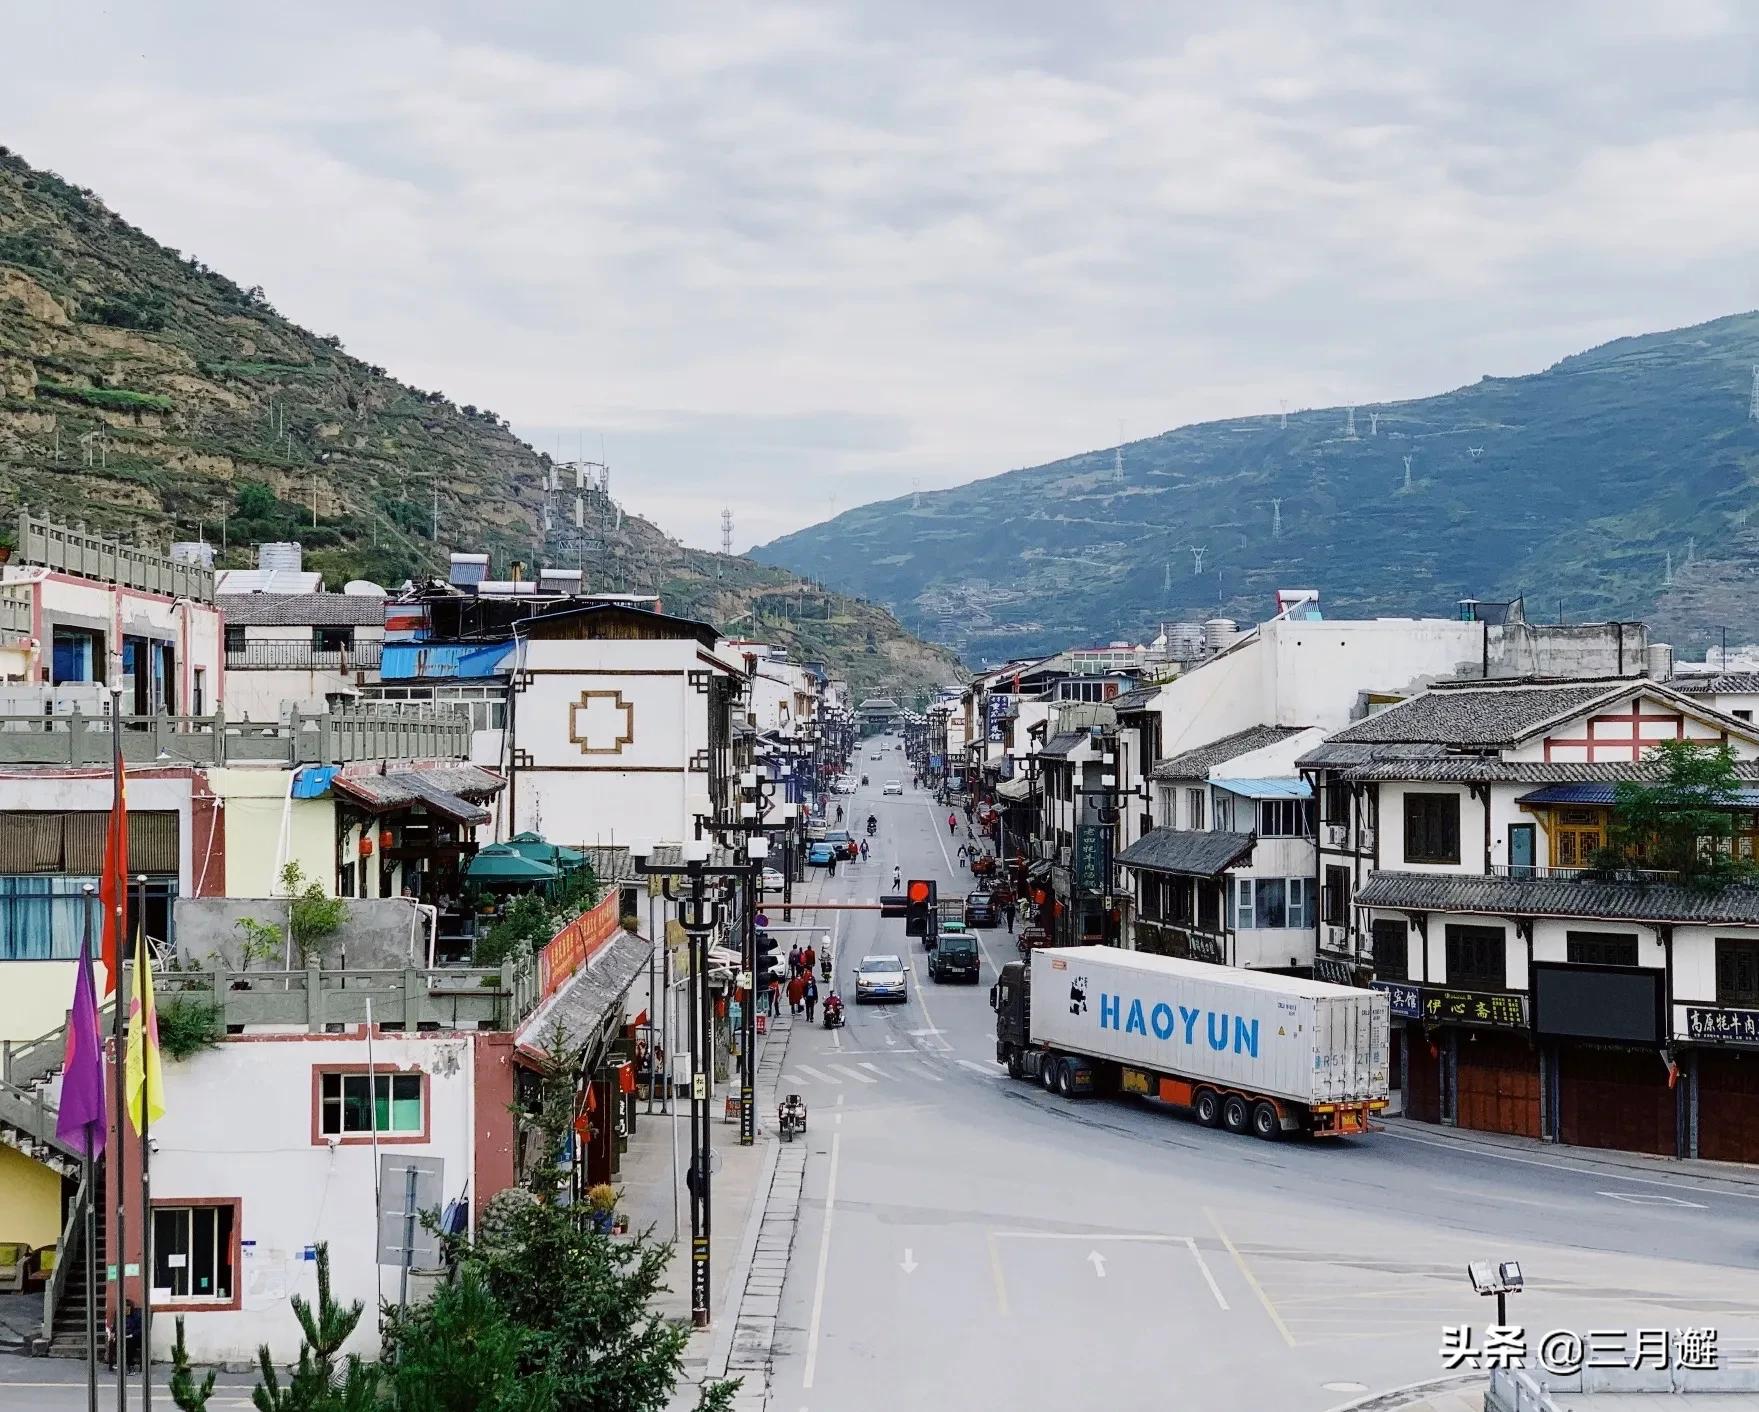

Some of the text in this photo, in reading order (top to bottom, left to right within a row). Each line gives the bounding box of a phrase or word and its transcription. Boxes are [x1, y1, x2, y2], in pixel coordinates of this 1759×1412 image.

[1100, 992, 1260, 1059] HAOYUN
[1690, 1009, 1759, 1036] 高原牦牛肉
